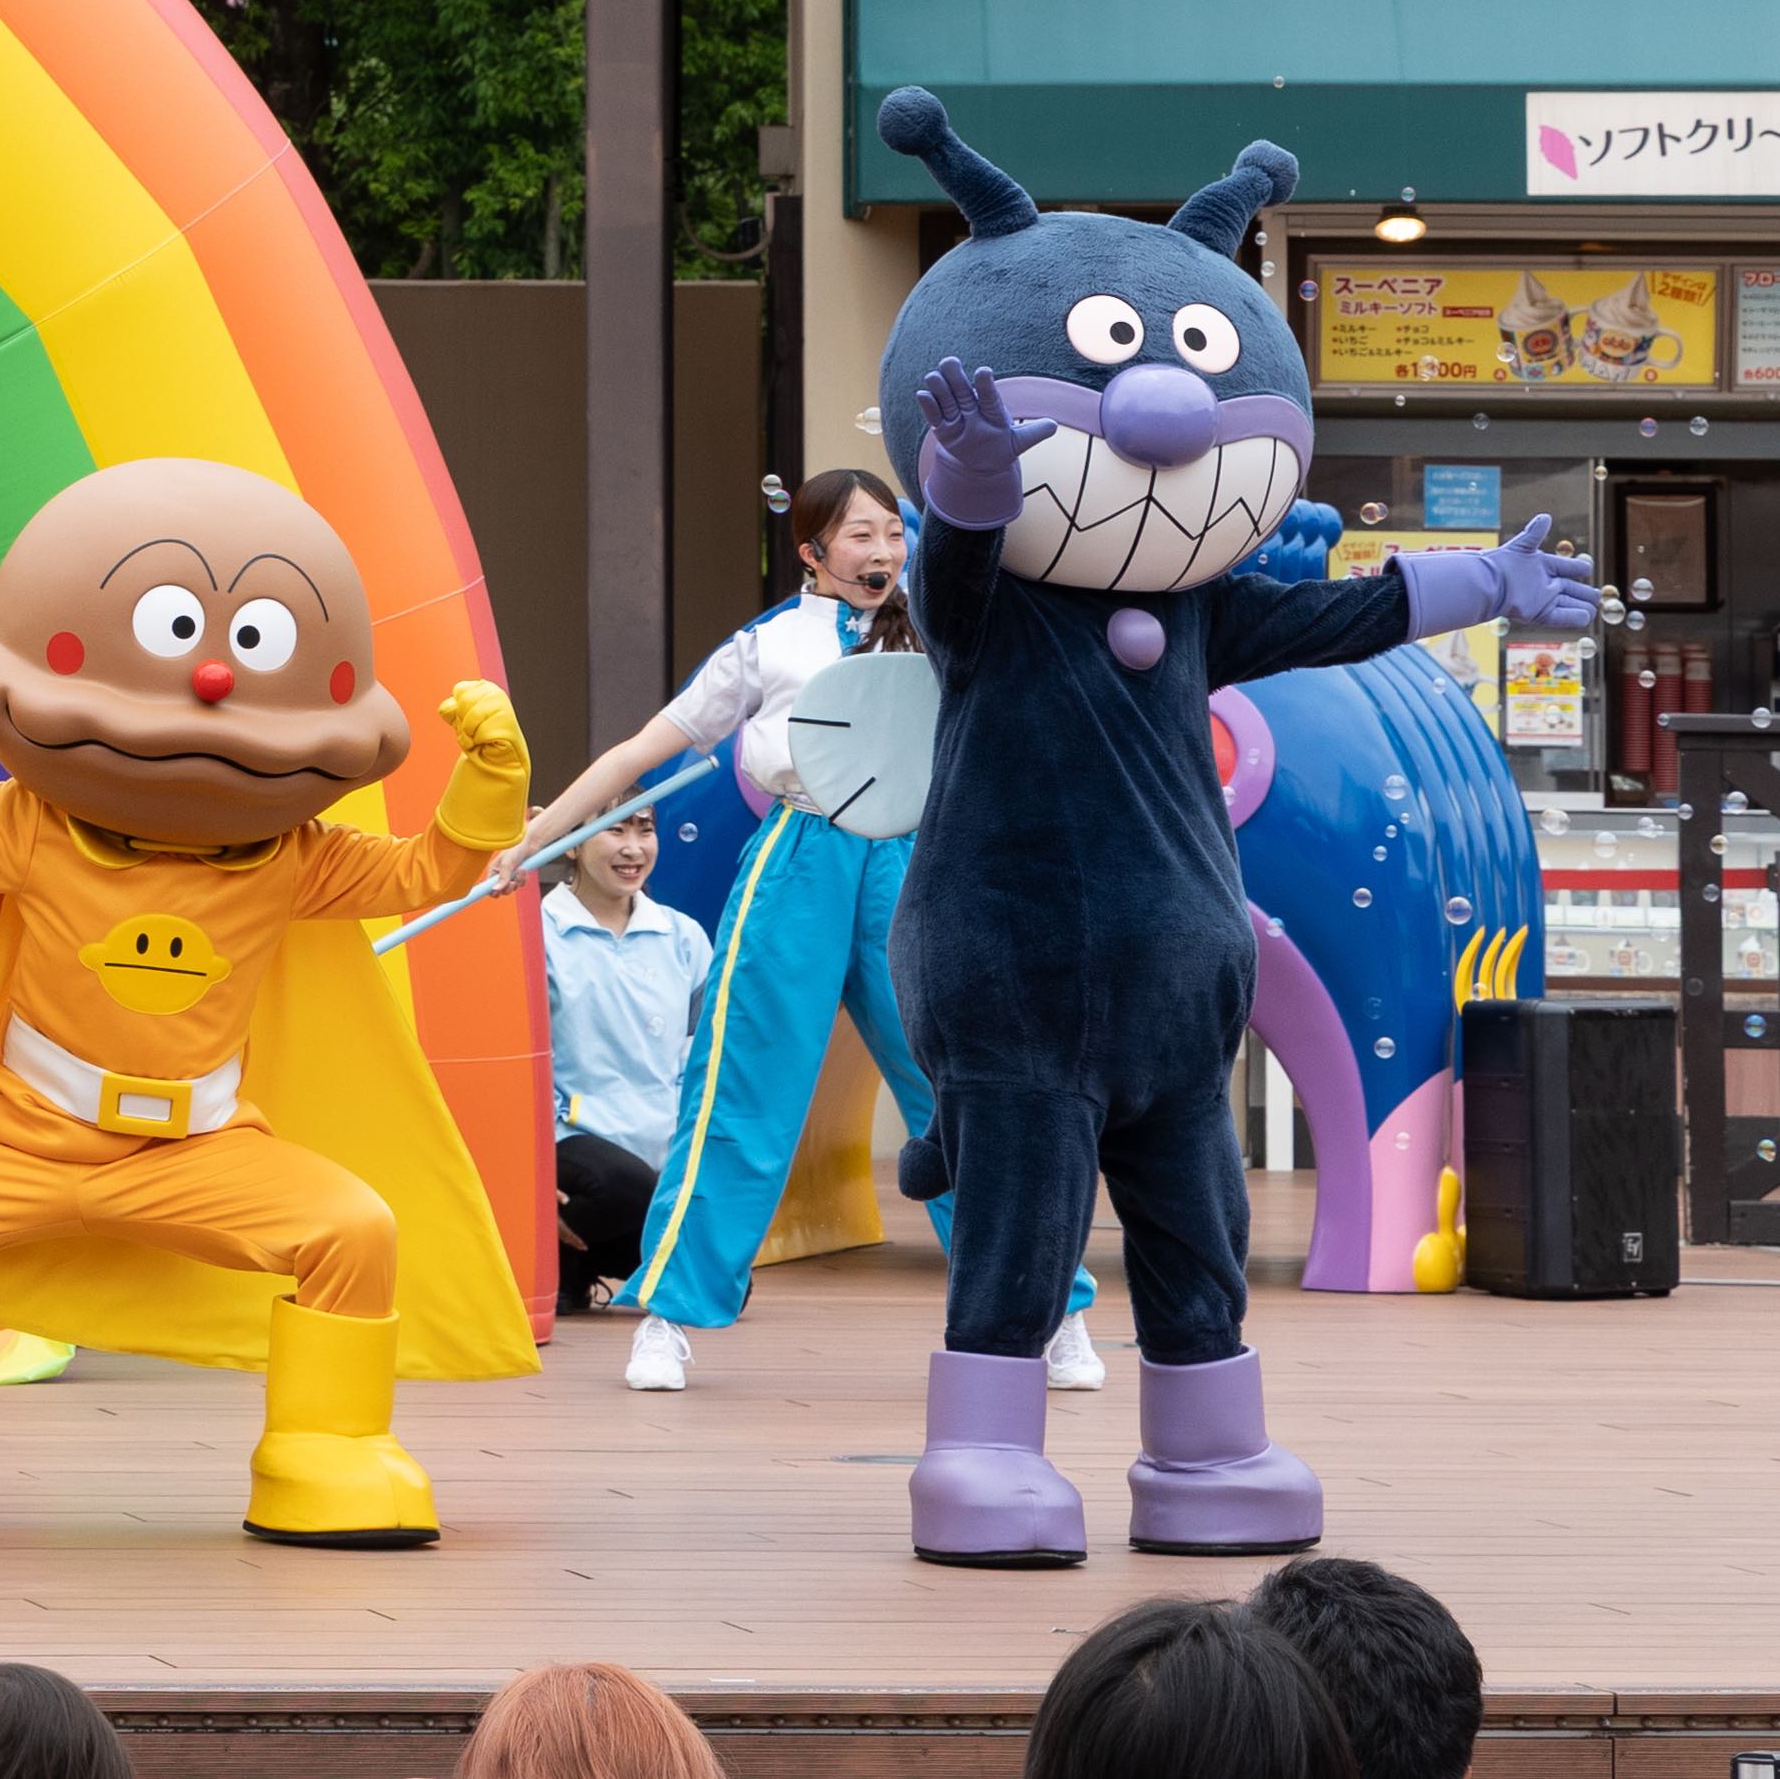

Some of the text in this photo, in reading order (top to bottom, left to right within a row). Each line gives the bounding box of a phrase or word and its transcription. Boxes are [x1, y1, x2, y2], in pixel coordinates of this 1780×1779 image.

[1334, 277, 1442, 295] スーベニア
[1339, 301, 1438, 316] ミルキーソフト
[1338, 324, 1377, 333] ミルキー
[1402, 324, 1430, 333] チョコ
[1338, 336, 1368, 345] いちご
